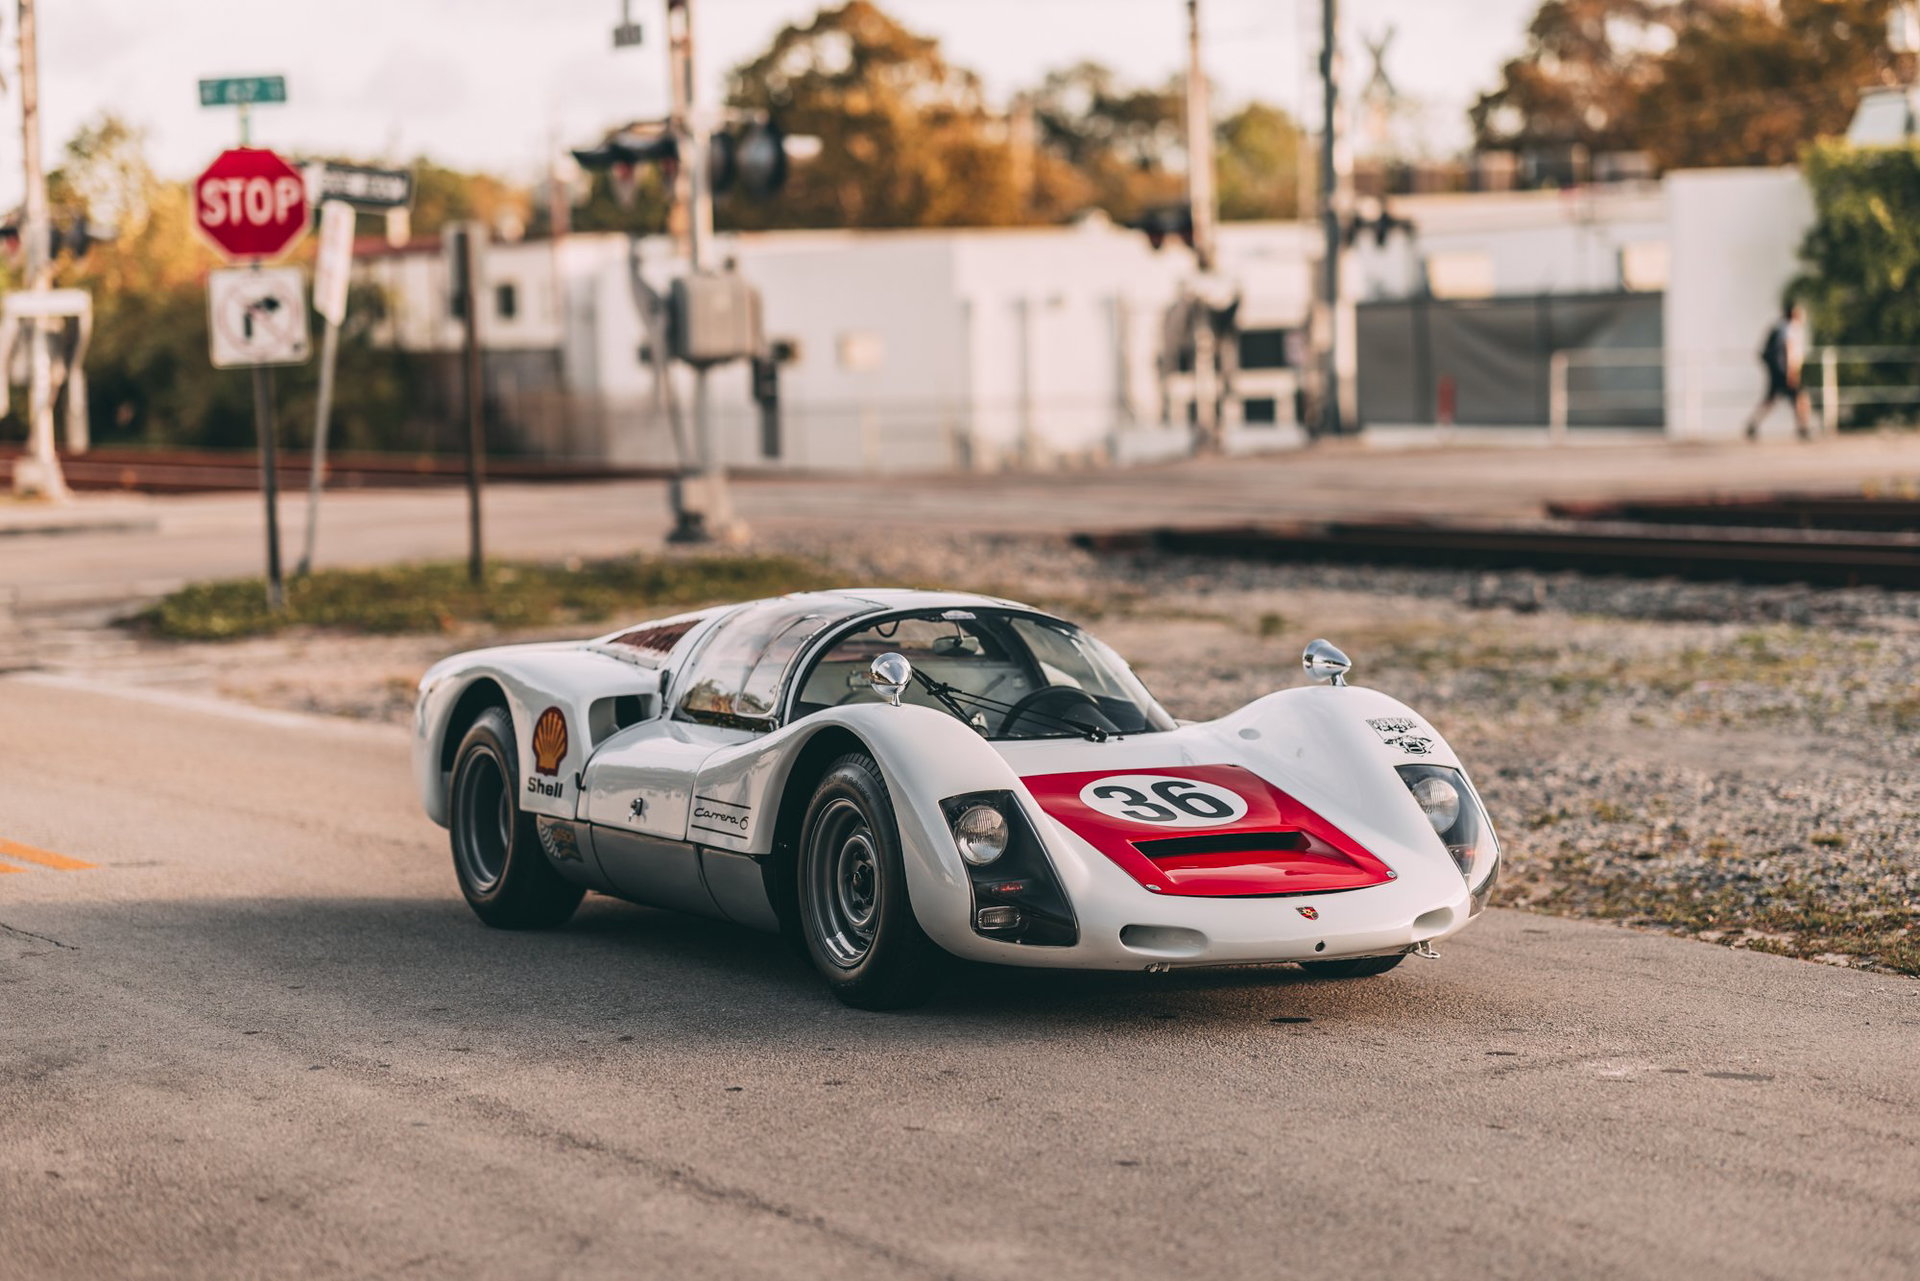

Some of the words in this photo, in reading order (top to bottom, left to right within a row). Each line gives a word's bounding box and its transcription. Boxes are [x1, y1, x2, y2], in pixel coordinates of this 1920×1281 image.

[201, 176, 300, 227] STOP
[527, 777, 564, 798] Shell
[1093, 781, 1235, 822] 36
[694, 807, 738, 825] Carrera
[739, 816, 749, 831] 6
